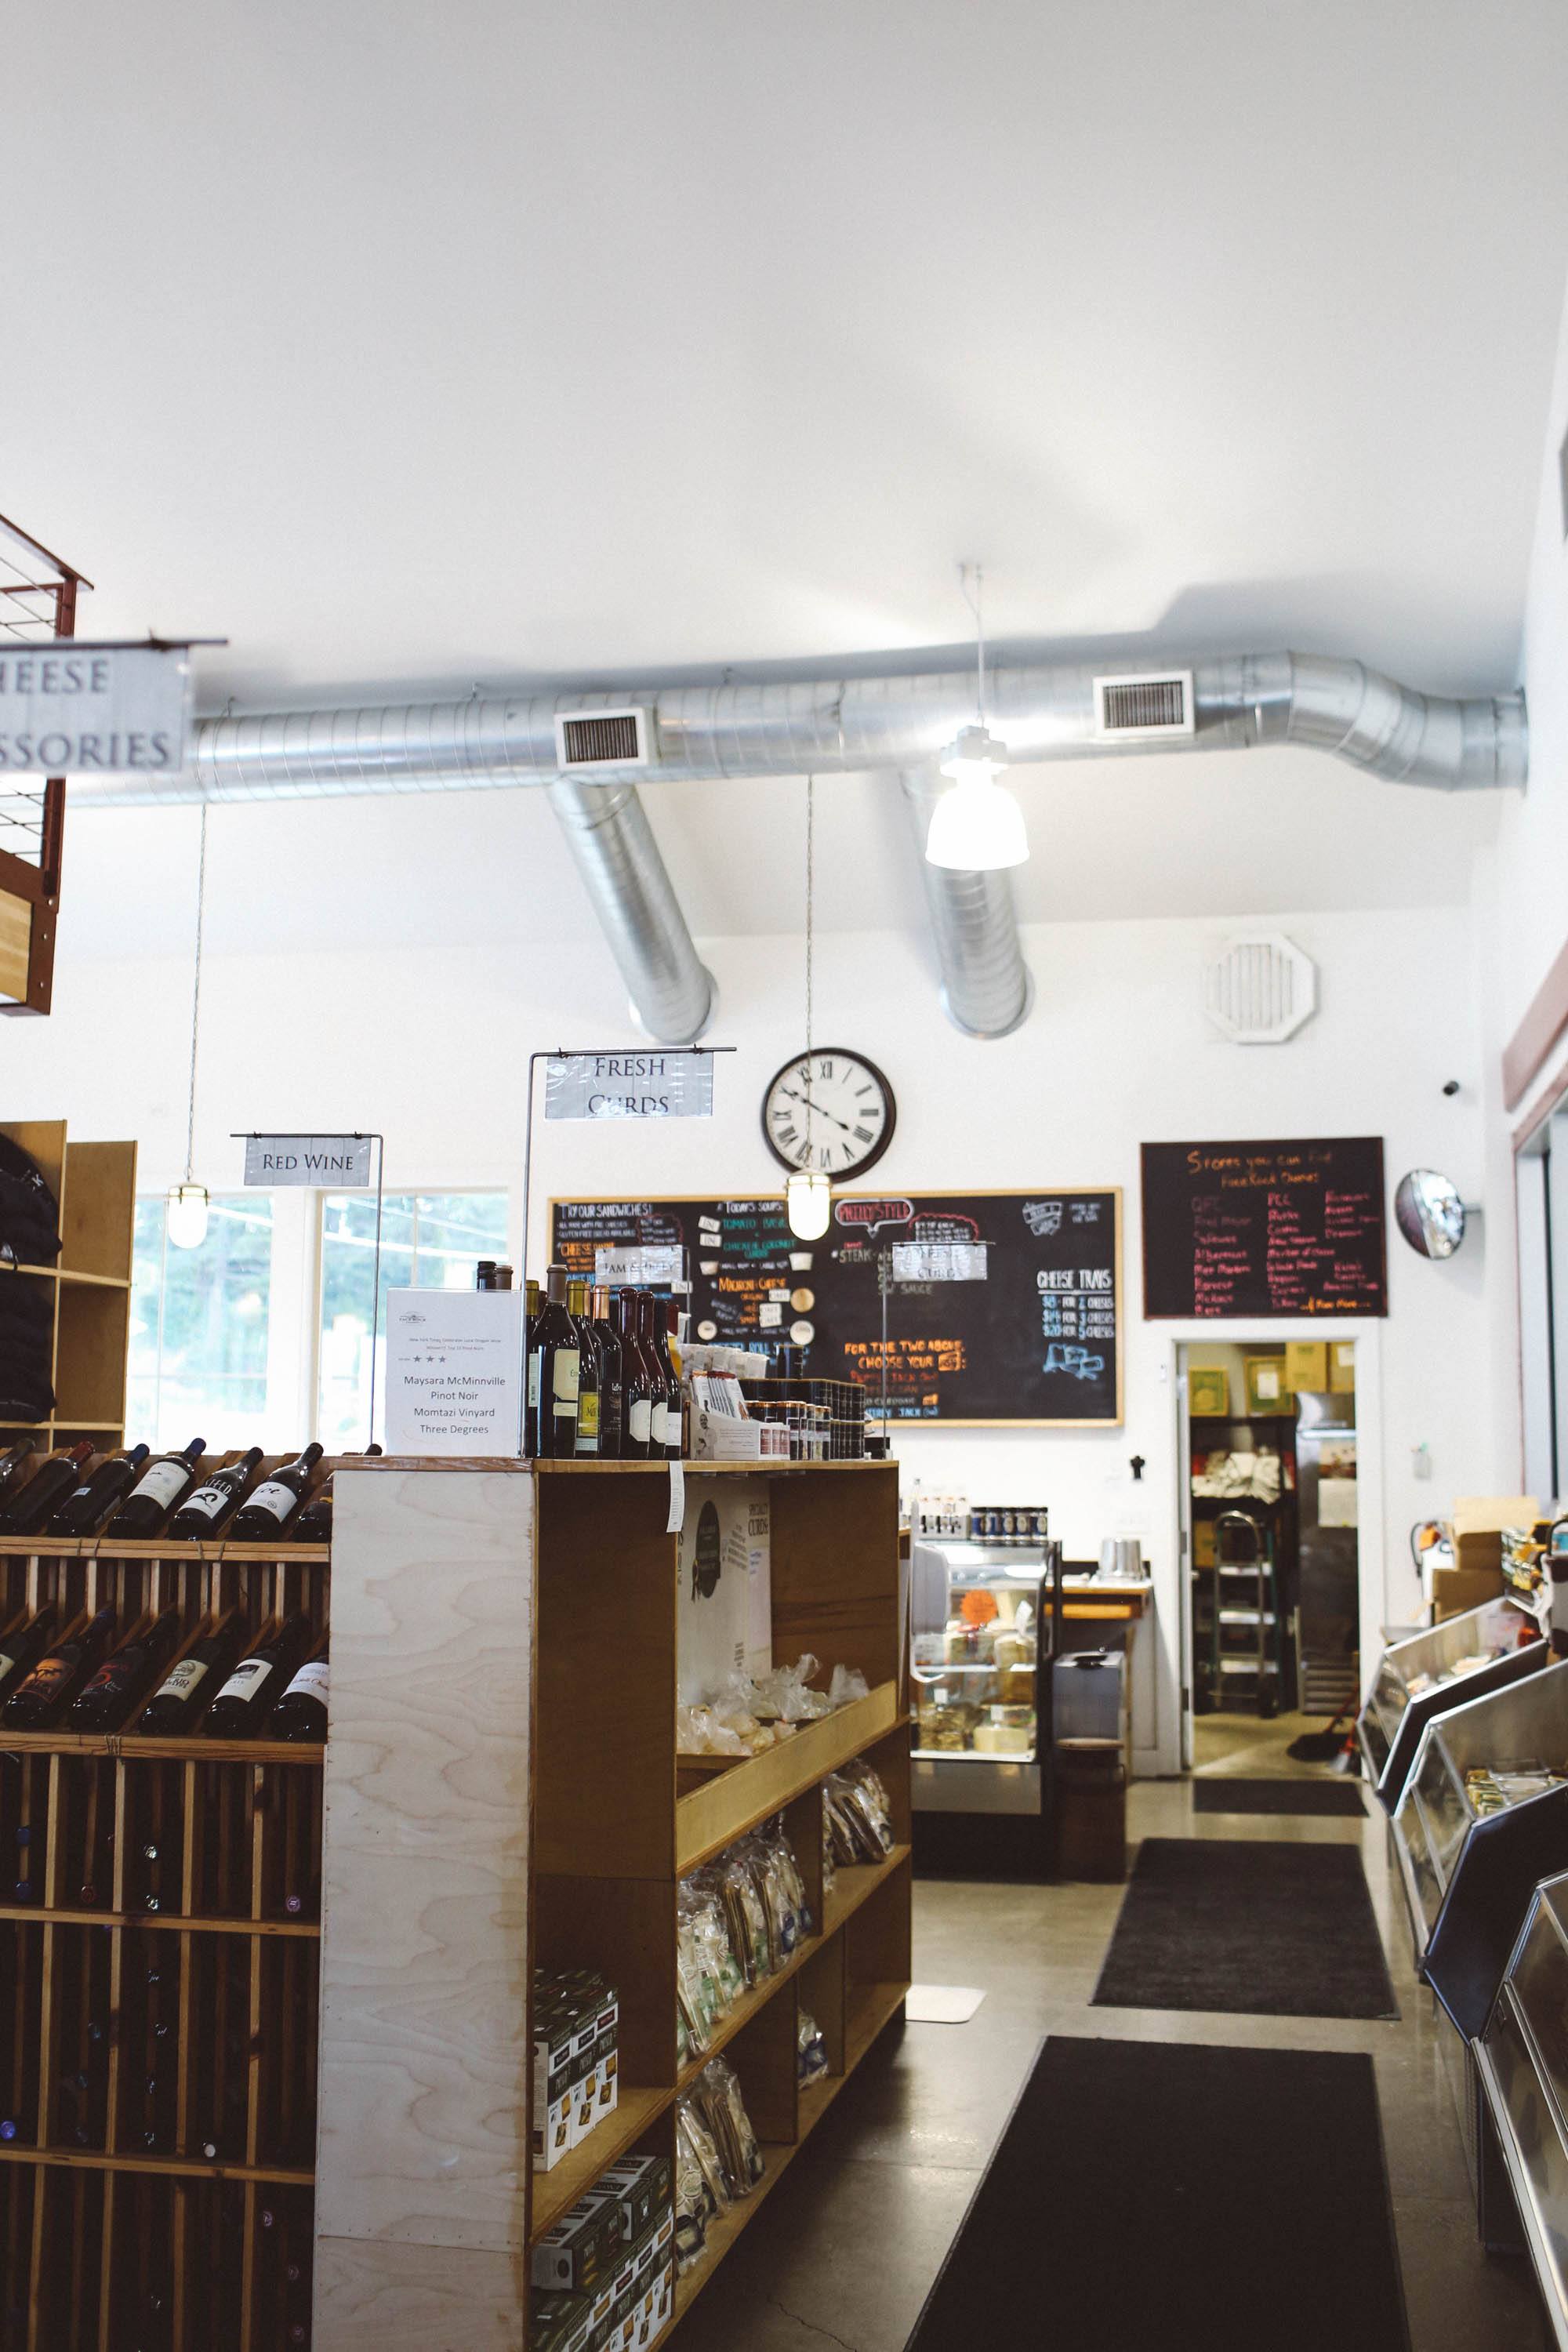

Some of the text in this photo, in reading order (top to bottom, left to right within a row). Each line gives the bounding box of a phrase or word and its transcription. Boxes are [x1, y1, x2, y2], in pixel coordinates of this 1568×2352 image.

[0, 659, 108, 693] EESE
[594, 1058, 666, 1076] FRESH
[820, 1061, 833, 1080] XII
[842, 1066, 853, 1084] I
[855, 1084, 873, 1098] II
[588, 1094, 669, 1114] CURDS
[860, 1108, 879, 1116] III
[842, 1142, 855, 1161] V
[263, 1154, 354, 1170] RED WINE
[579, 1204, 596, 1218] OUR
[1036, 1269, 1112, 1289] CHEESE TRAYS
[844, 1343, 868, 1356] FOR
[870, 1341, 896, 1353] THE
[899, 1340, 926, 1352] TWO
[858, 1356, 902, 1369] CHOOSE
[907, 1355, 935, 1368] YOUR
[404, 1376, 506, 1386] Maysara McMinnville
[430, 1391, 478, 1400] Pinot Noir
[414, 1408, 495, 1418] Momtazi Vinyard
[420, 1425, 488, 1436] Three Degrees
